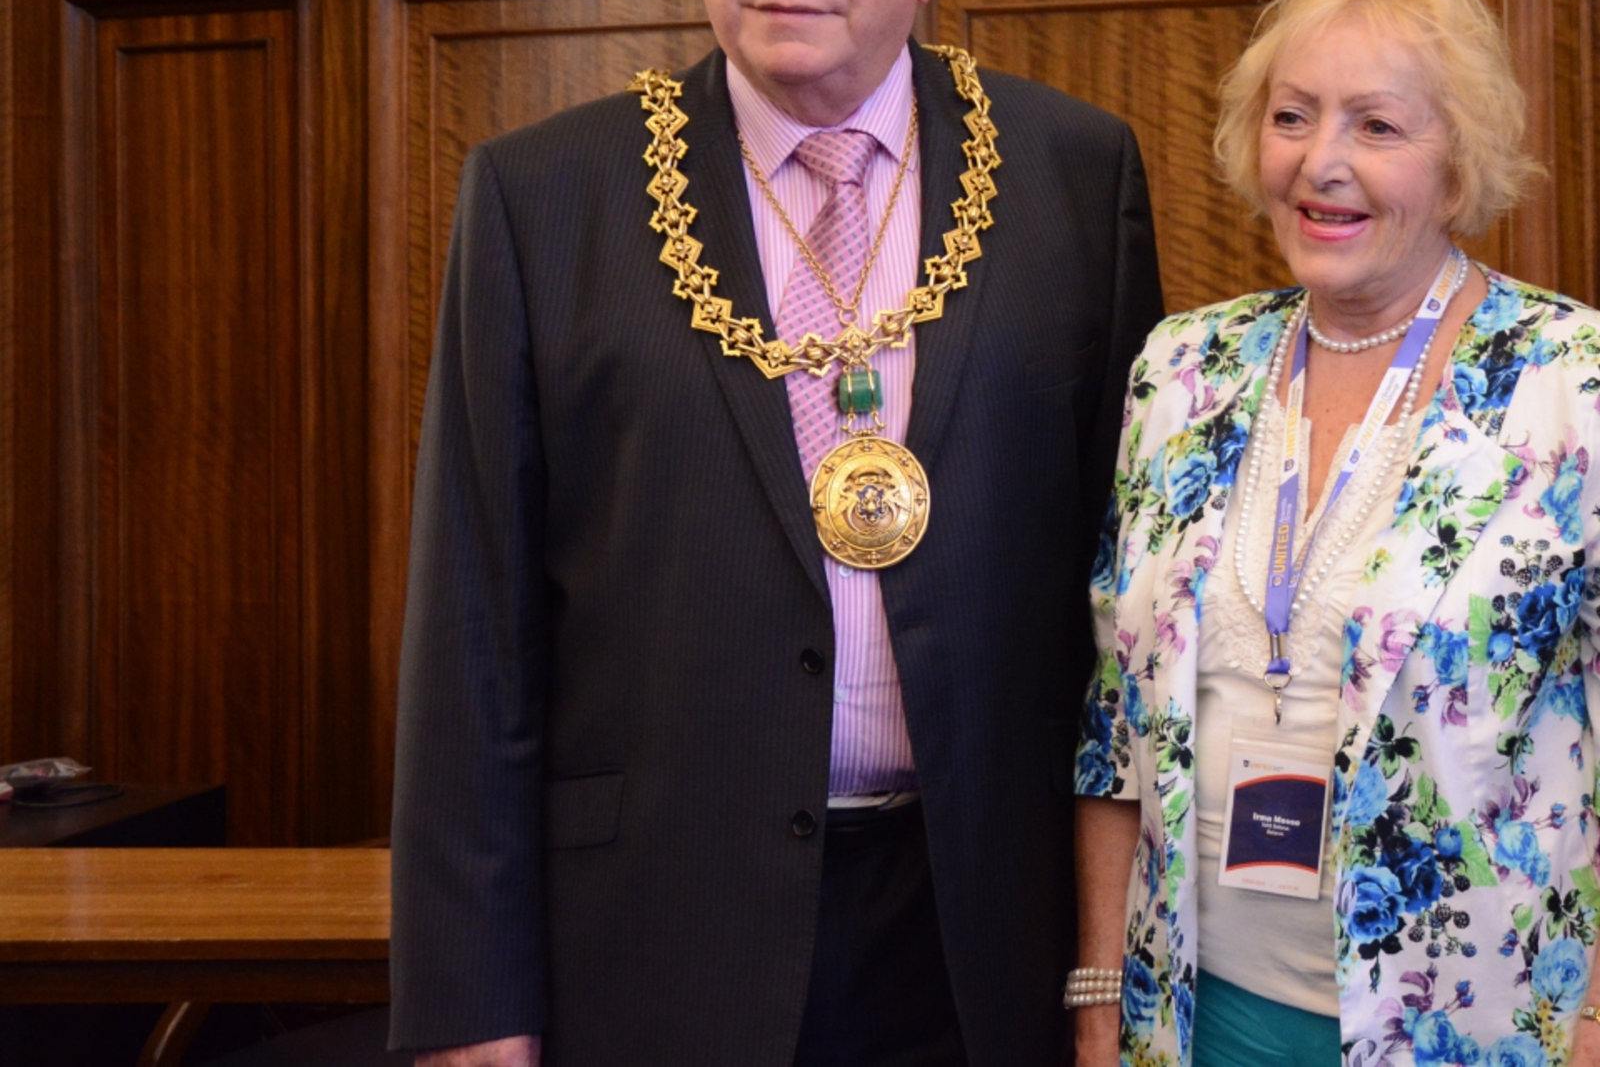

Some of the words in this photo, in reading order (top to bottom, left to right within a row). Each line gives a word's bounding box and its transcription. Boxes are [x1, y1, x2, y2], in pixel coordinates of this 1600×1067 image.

[1285, 406, 1298, 458] UNITED
[1358, 399, 1388, 451] UNITED
[1273, 523, 1290, 574] UNITED
